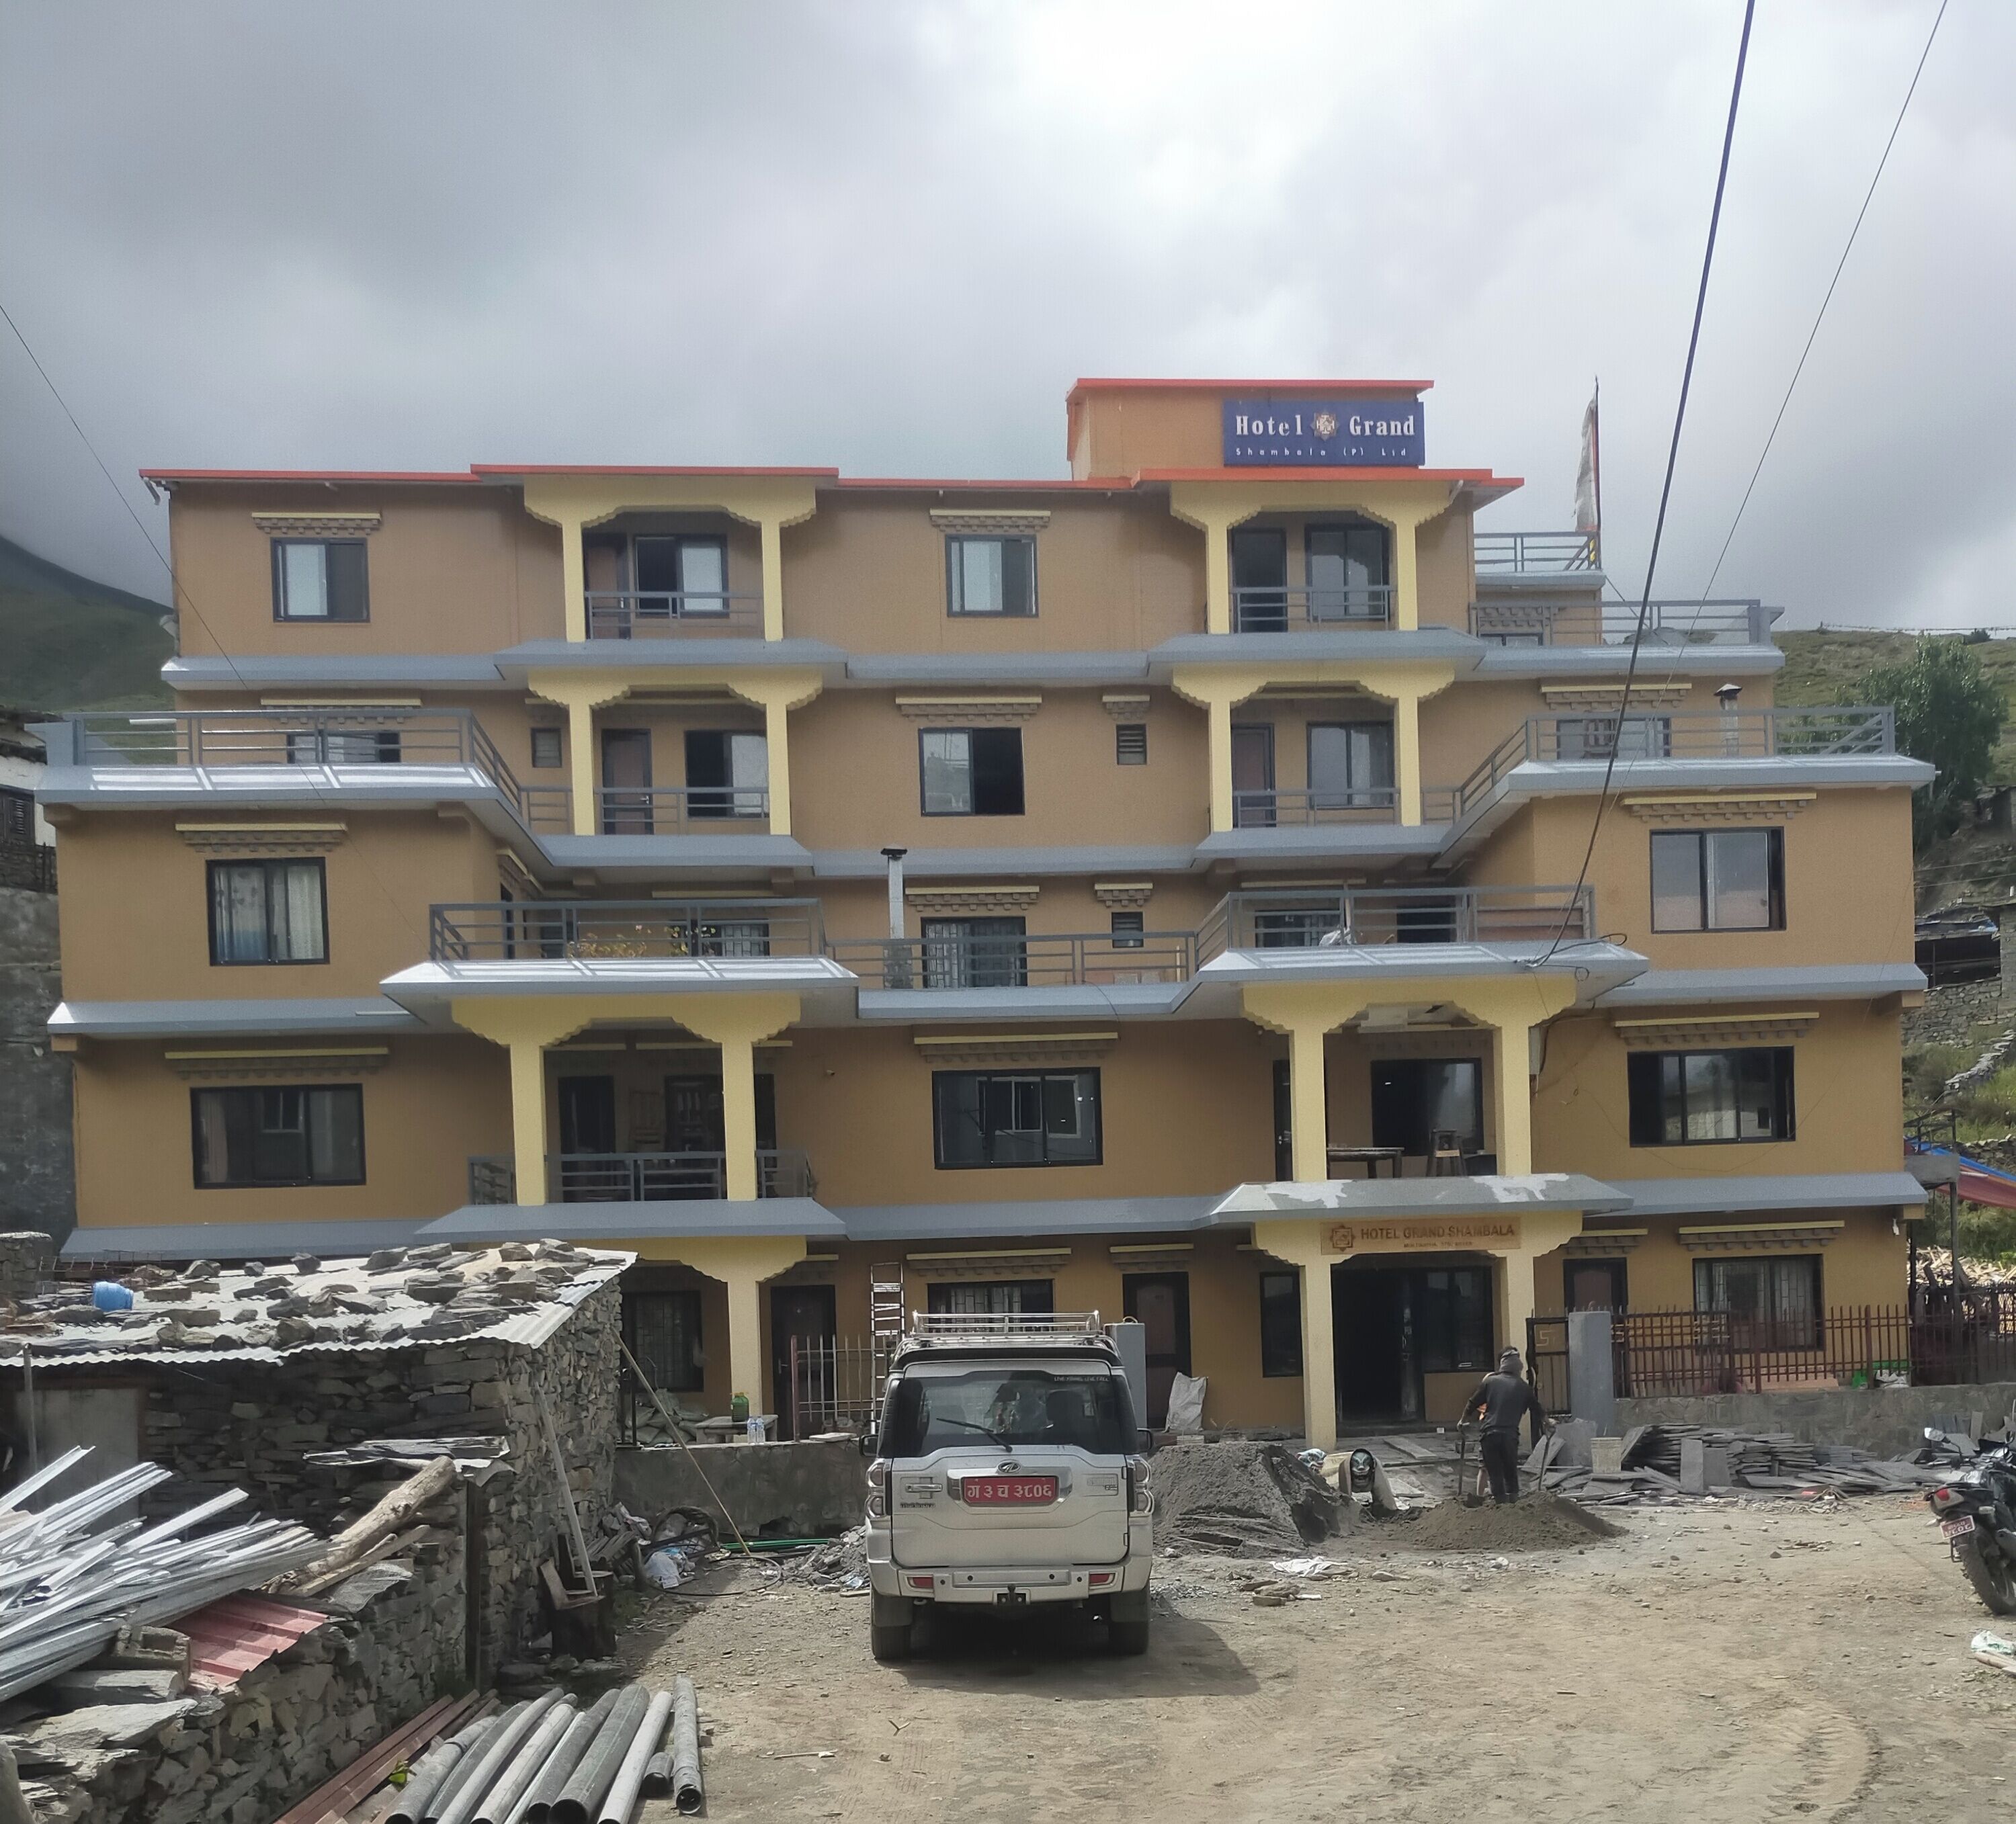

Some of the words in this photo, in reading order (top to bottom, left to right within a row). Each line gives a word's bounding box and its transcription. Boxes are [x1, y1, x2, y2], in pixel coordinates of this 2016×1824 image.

[1236, 415, 1302, 435] Hotel
[1349, 415, 1415, 436] Grand
[1236, 447, 1326, 456] Shambala
[1343, 447, 1363, 457] (P)
[1361, 1227, 1400, 1240] HOTEL
[1403, 1226, 1445, 1239] GRAND
[1448, 1224, 1515, 1237] SHAMBALA
[967, 1485, 980, 1498] ग
[983, 1485, 993, 1498] ३
[997, 1485, 1010, 1498] च
[1013, 1484, 1052, 1498] ३८०६
